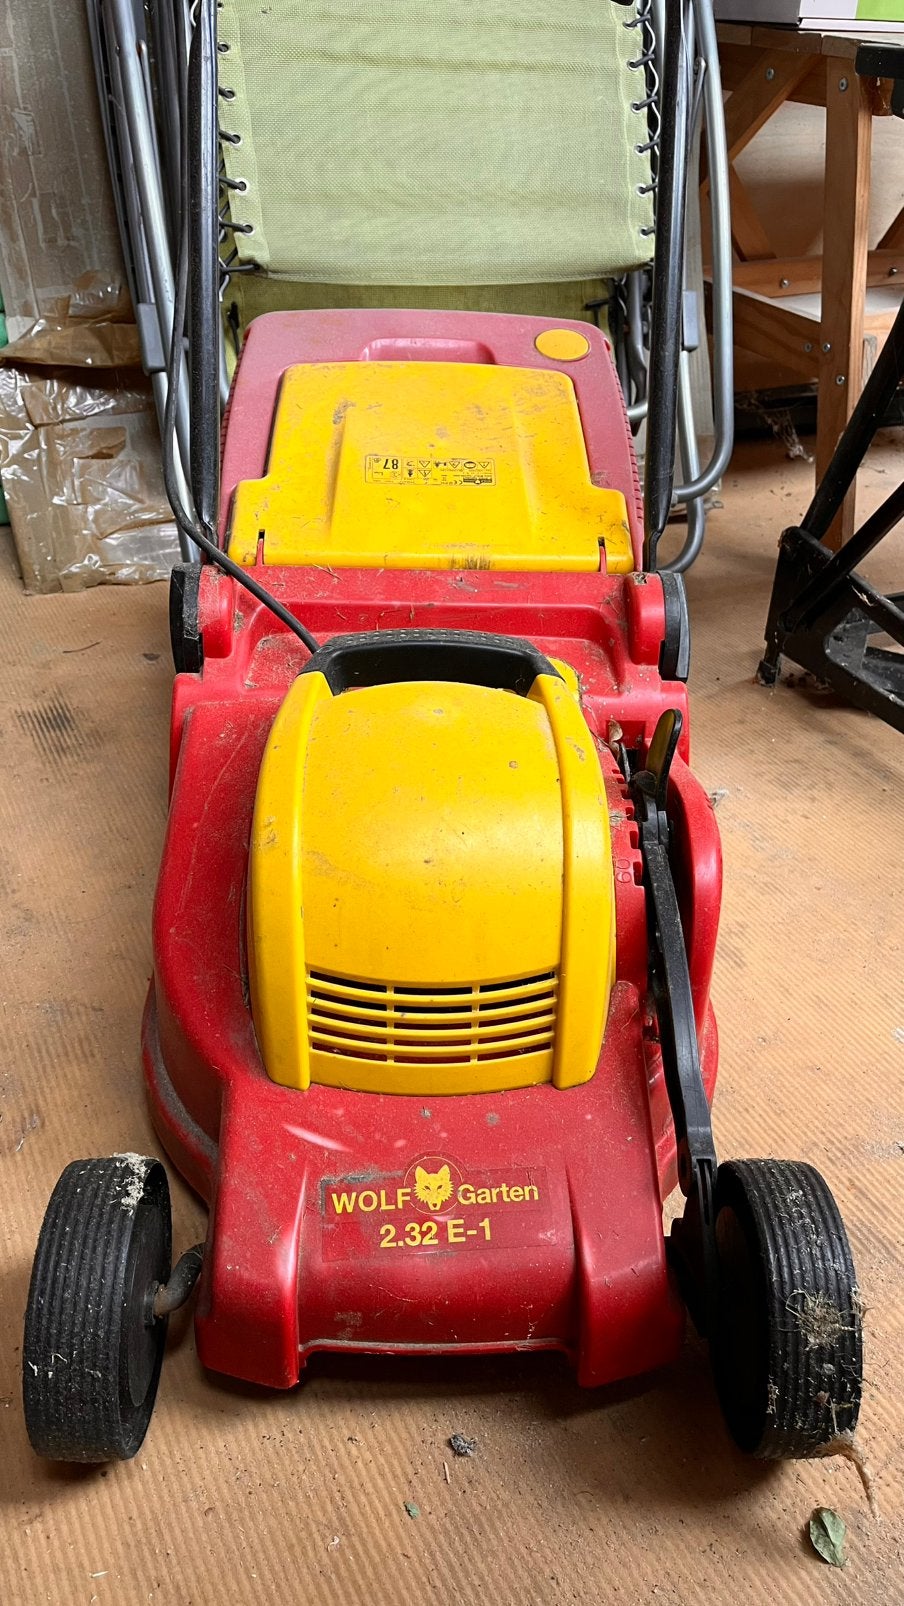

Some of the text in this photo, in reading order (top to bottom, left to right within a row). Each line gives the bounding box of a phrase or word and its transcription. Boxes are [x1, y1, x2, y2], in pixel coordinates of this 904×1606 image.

[383, 458, 399, 470] 87
[331, 1183, 539, 1214] WOLF Garten
[379, 1218, 492, 1248] 2.32 E-1
